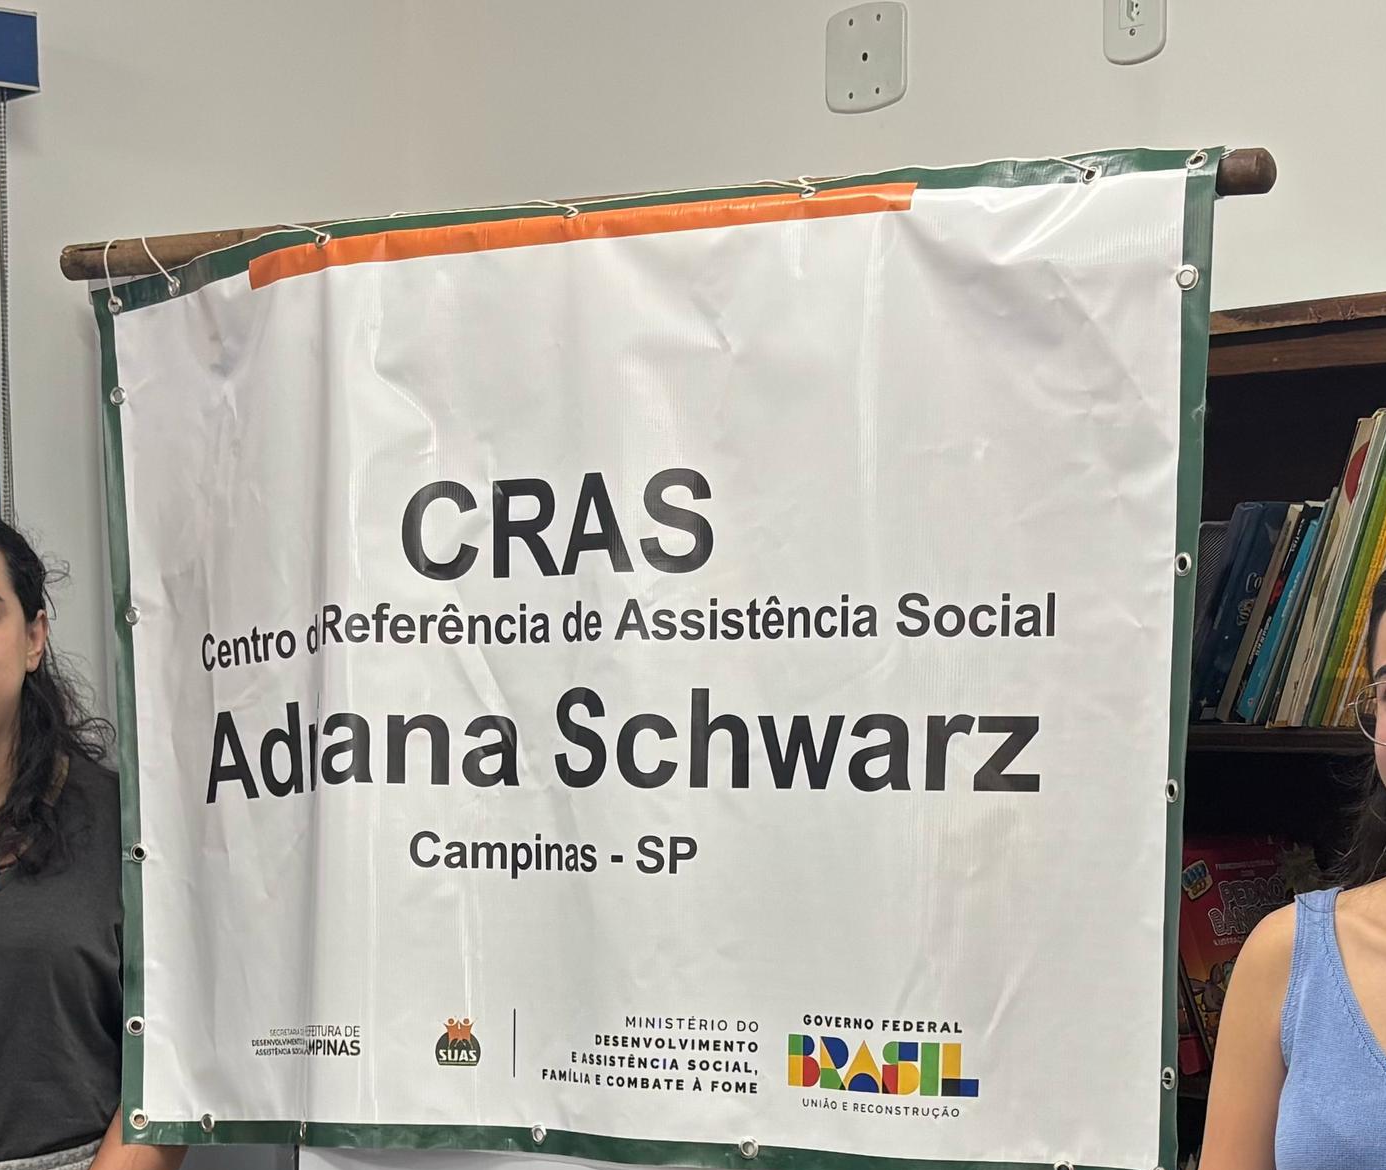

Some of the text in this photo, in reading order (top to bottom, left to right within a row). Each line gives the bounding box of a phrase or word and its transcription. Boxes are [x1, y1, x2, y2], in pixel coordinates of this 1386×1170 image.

[402, 469, 713, 580] CRAS
[202, 626, 295, 672] Centro
[323, 603, 549, 645] Referência
[563, 601, 601, 642] de
[615, 595, 877, 641] Assistência
[897, 592, 1055, 638] Social
[555, 687, 1039, 792] Schwarz
[410, 830, 596, 879] Campinas
[636, 836, 698, 874] SP
[344, 1025, 361, 1037] DE
[625, 1015, 759, 1033] MINISTÉRIO DO
[803, 1014, 963, 1034] GOVERNO FEDERAL
[438, 1049, 477, 1061] SUAS
[594, 1034, 759, 1053] DESENVOLVIMENTO
[571, 1051, 758, 1075] E ASSISTÊNCIA SOCIAL,
[788, 1034, 979, 1097] BRASIL
[541, 1068, 758, 1094] FAMÍLIA E COMBATE À FOME
[802, 1097, 960, 1119] UNIÃO E RECONSTRUÇÃO
